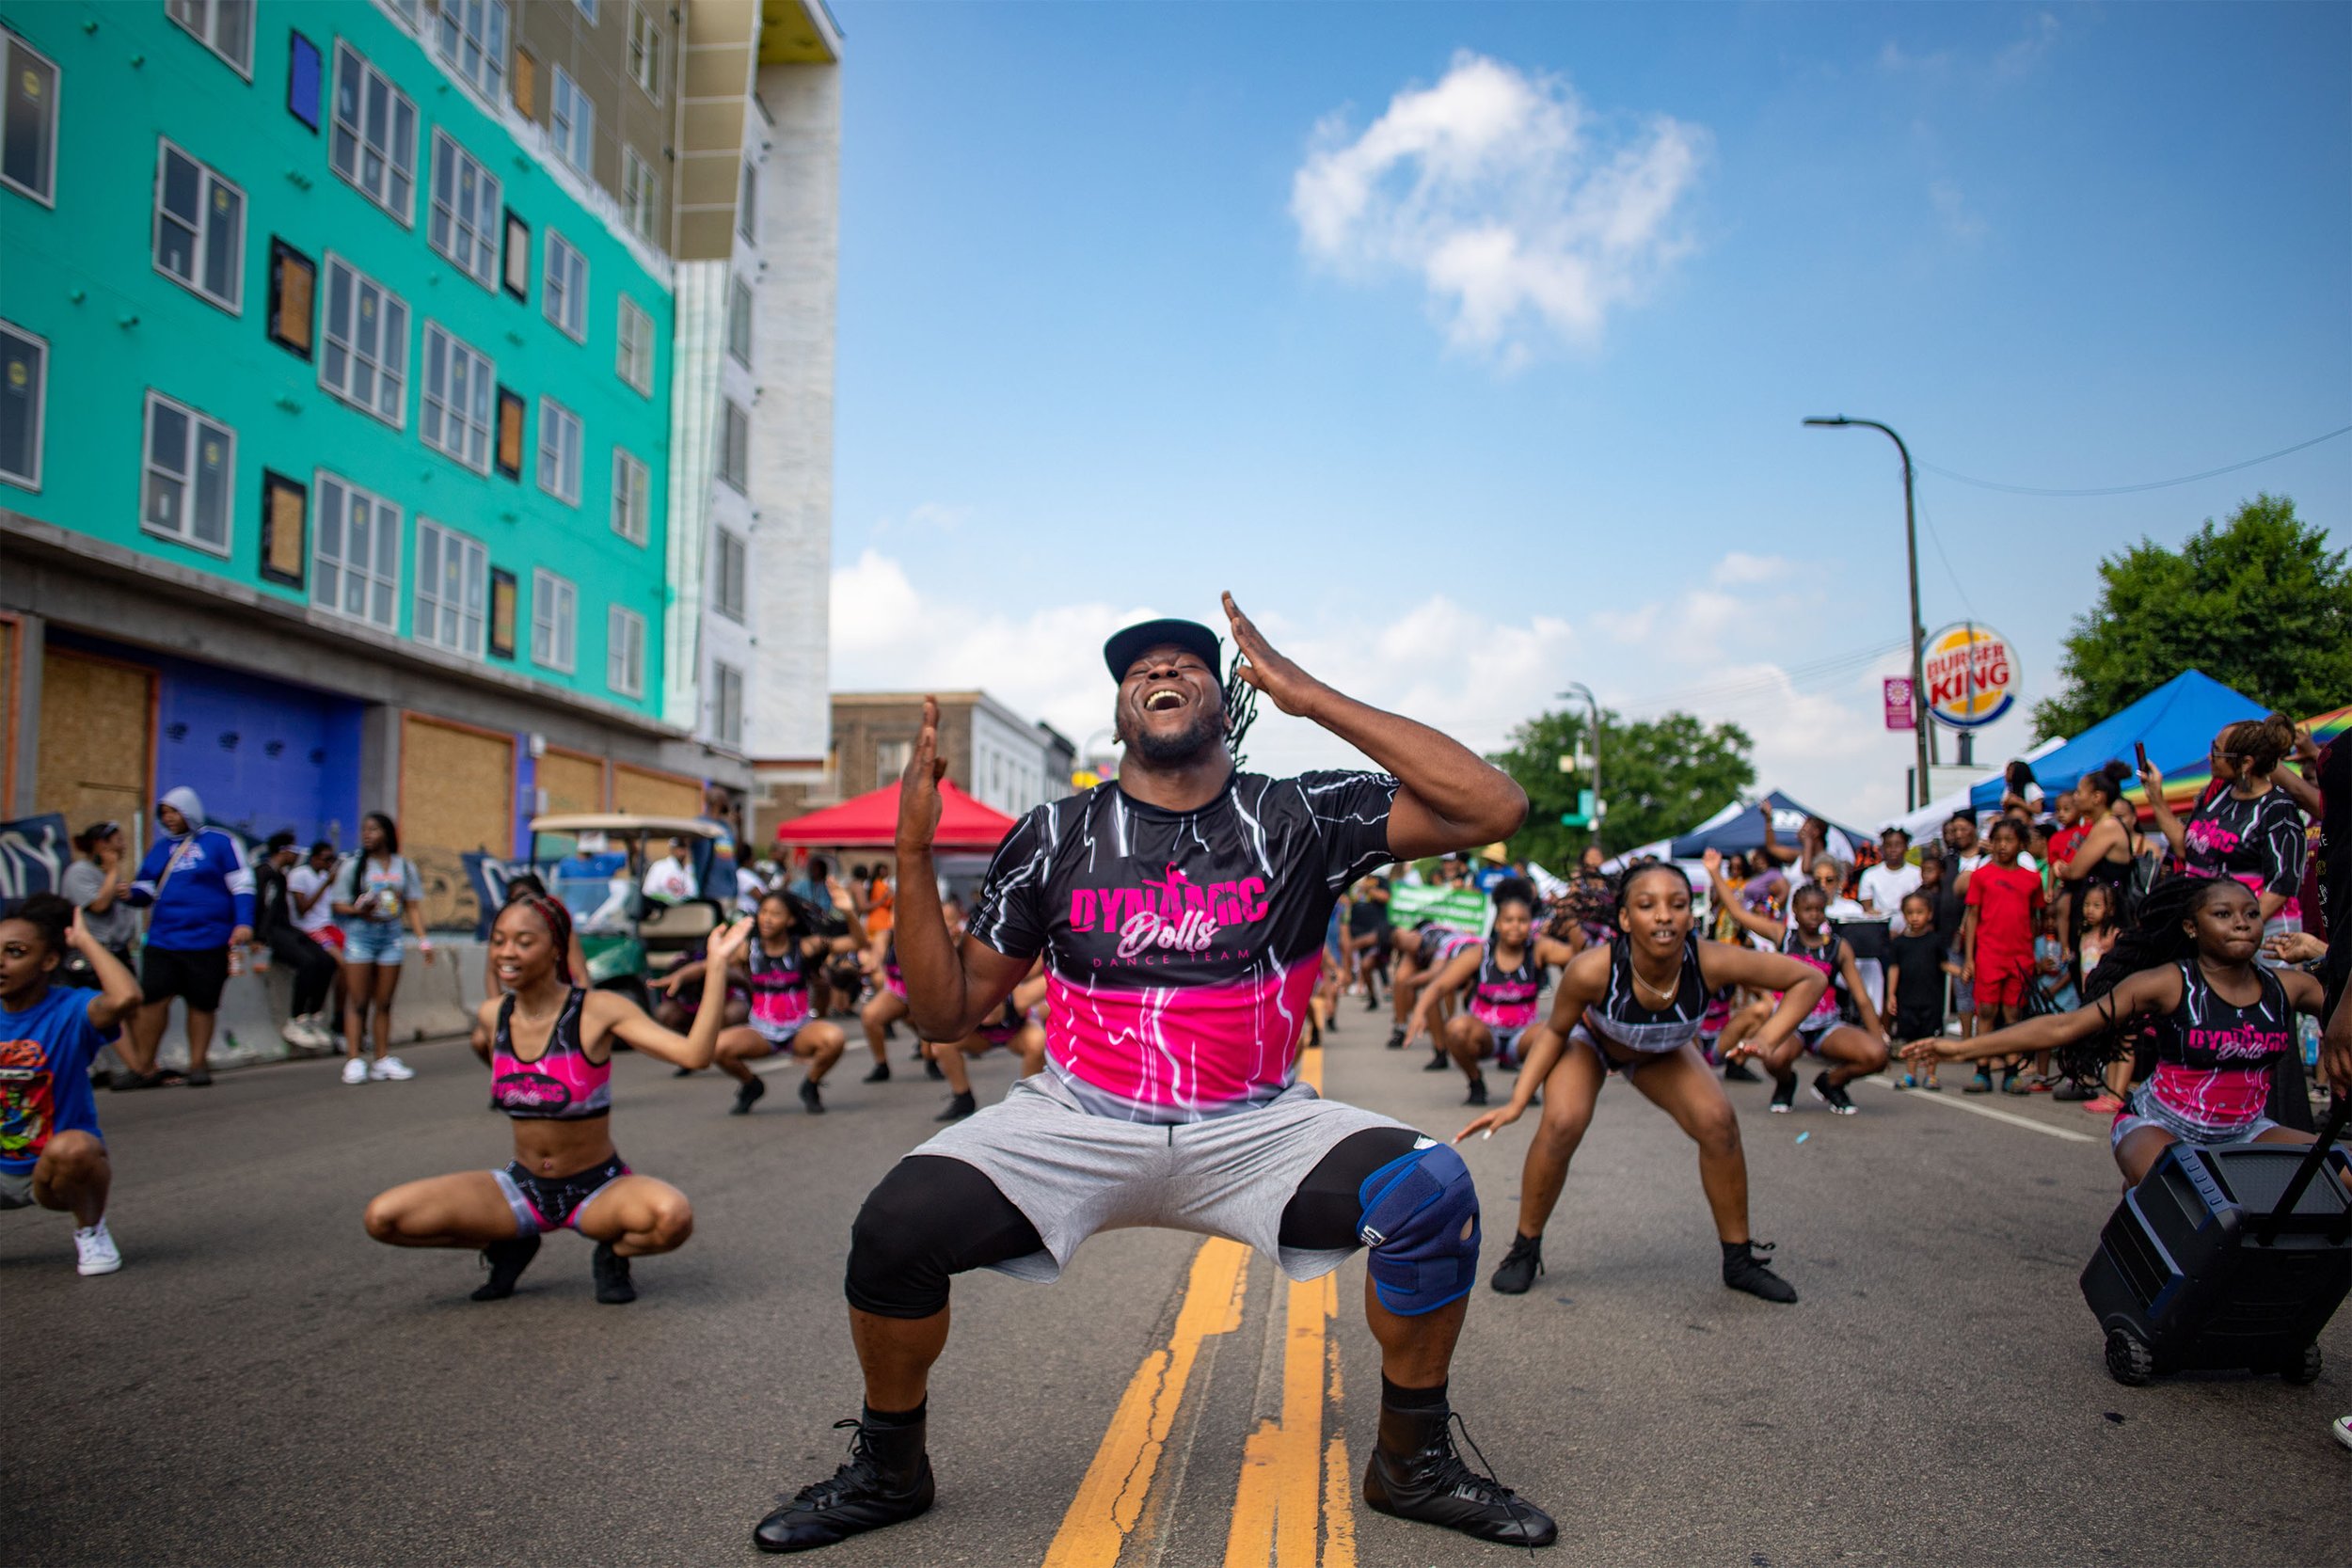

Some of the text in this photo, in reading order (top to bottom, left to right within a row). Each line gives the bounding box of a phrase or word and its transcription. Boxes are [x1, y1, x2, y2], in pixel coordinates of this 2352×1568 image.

[1931, 662, 2010, 709] KING
[1069, 876, 1270, 934] DYNAMIC
[1117, 908, 1221, 959] Dolls
[1092, 948, 1250, 969] DANCE TEAM
[2188, 1028, 2289, 1053] DYNAMIC
[2216, 1040, 2267, 1061] Dolls
